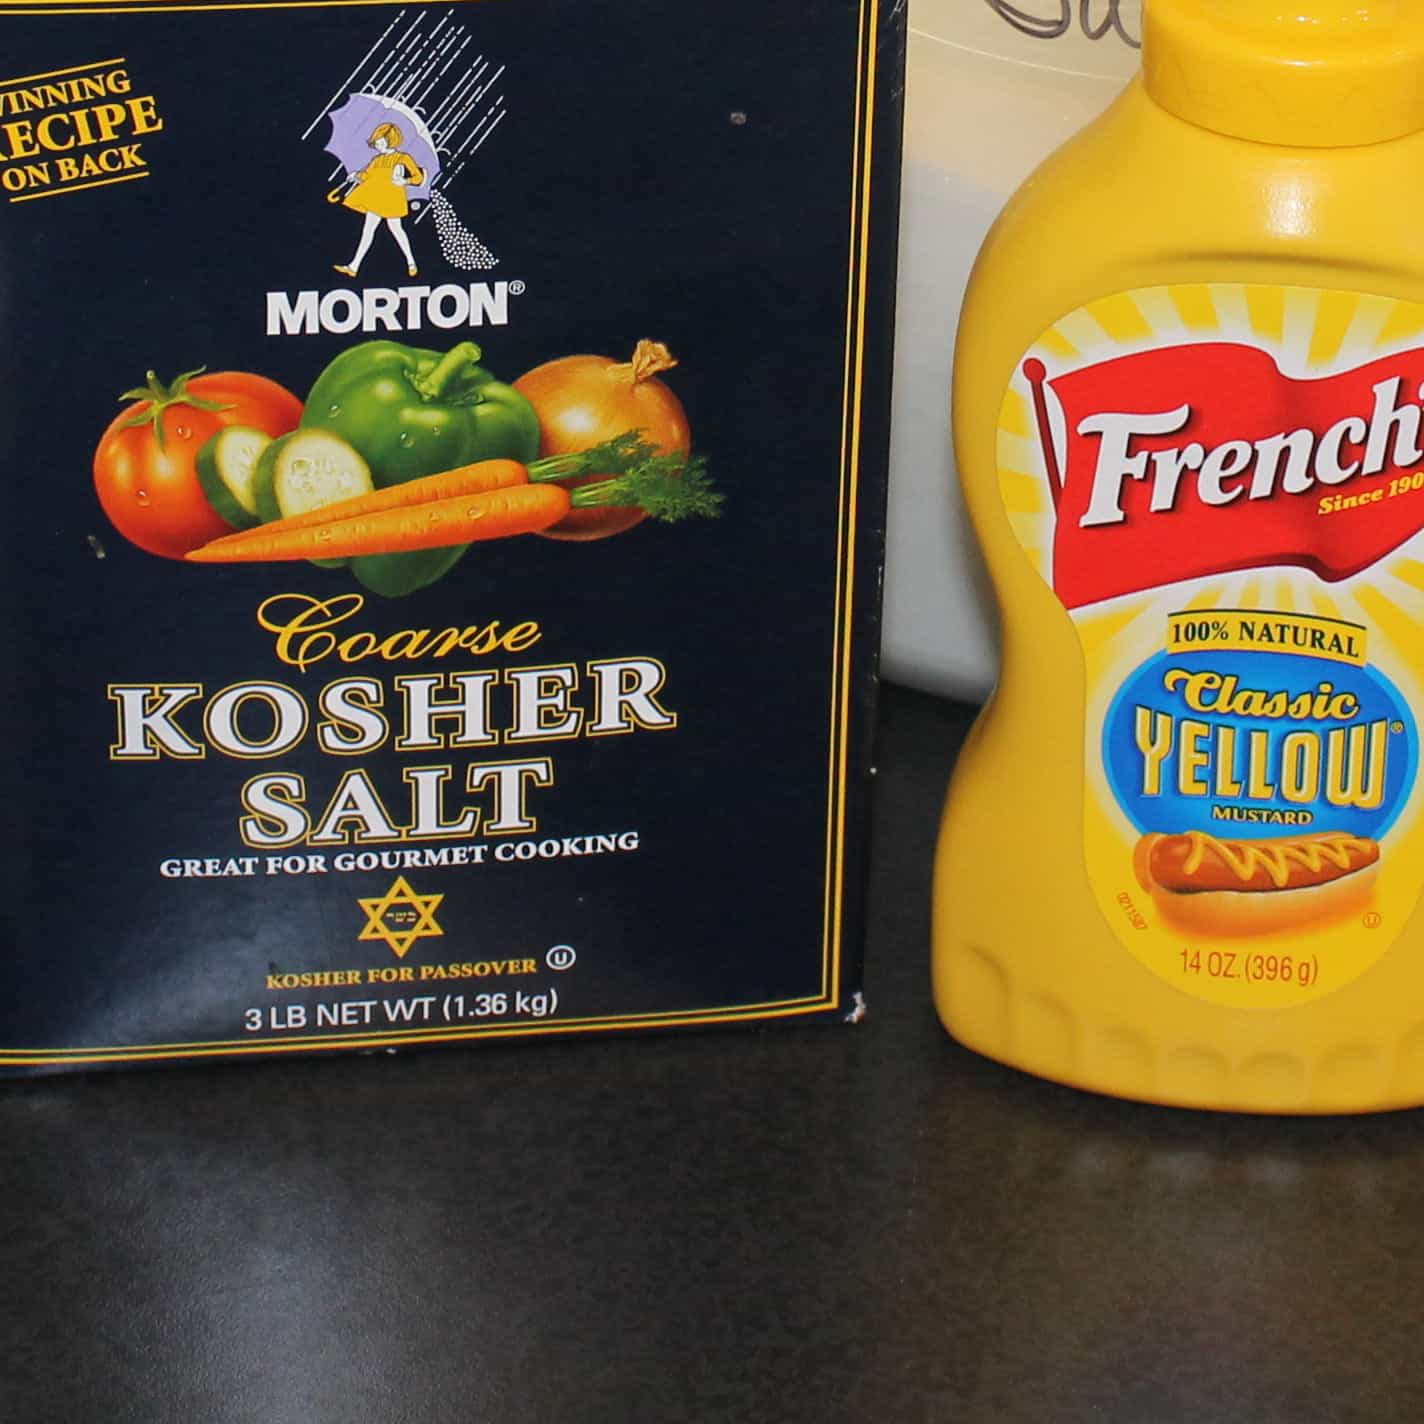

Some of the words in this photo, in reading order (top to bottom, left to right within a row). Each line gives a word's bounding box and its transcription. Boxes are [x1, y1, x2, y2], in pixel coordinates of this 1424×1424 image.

[1, 162, 51, 191] ON
[55, 143, 147, 182] BACK
[266, 280, 508, 335] MORTON
[1317, 485, 1384, 516] Since
[256, 594, 542, 673] Coarse
[1173, 620, 1229, 643] 100%
[1239, 621, 1360, 658] NATURAL
[108, 656, 676, 760] KOSHER
[1164, 667, 1360, 720] Classic
[1134, 705, 1389, 810] YELLOW
[240, 757, 554, 848] SALT
[1212, 805, 1314, 825] MUSTARD
[159, 857, 259, 878] GREAT
[266, 853, 328, 875] FOR
[334, 844, 488, 872] GOURMET
[494, 832, 640, 863] COOKING
[266, 969, 362, 990] KOSHER
[369, 965, 415, 984] FOR
[419, 957, 538, 980] PASSOVER
[1179, 948, 1202, 974] 14
[1244, 953, 1294, 984] (396
[1297, 954, 1320, 987] g)
[244, 1008, 263, 1031] 3
[269, 1005, 307, 1029] LB
[316, 1001, 377, 1026] NET
[383, 996, 436, 1022] WT
[443, 992, 508, 1022] (1.36
[514, 987, 558, 1016] kg)
